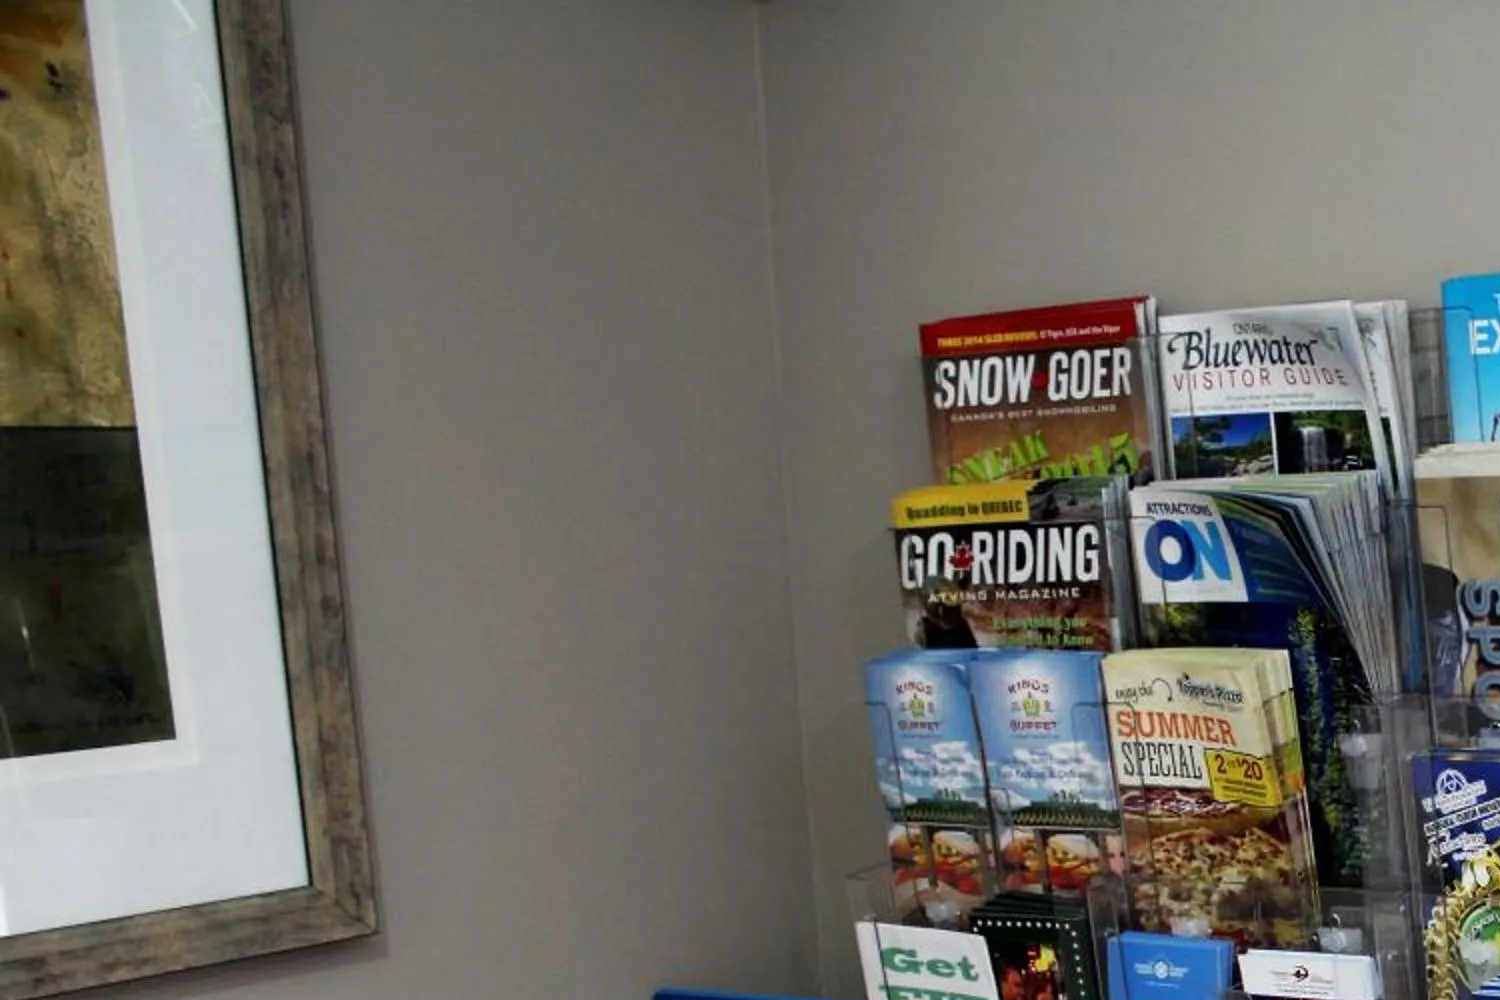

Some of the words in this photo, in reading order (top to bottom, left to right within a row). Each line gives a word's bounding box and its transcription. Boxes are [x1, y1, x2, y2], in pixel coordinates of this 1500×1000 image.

[1167, 325, 1319, 371] Bluewater
[933, 353, 1036, 411] SNOW
[1047, 346, 1132, 402] GOER
[1173, 367, 1272, 392] VISITOR
[1284, 367, 1351, 387] GUIDE
[1007, 408, 1033, 420] BEST
[1146, 502, 1214, 517] ATTRACTIONS
[900, 531, 956, 590] GO
[971, 524, 1100, 586] RIDING
[1144, 518, 1233, 583] ON
[995, 587, 1082, 601] MAGAZINE
[896, 681, 933, 696] KINGS
[1008, 679, 1050, 695] KINGS
[1009, 719, 1057, 733] BUFFET
[1116, 708, 1238, 748] SUMMER
[1121, 740, 1203, 781] SPECIAL
[1215, 753, 1228, 775] 2
[879, 947, 980, 983] Get
